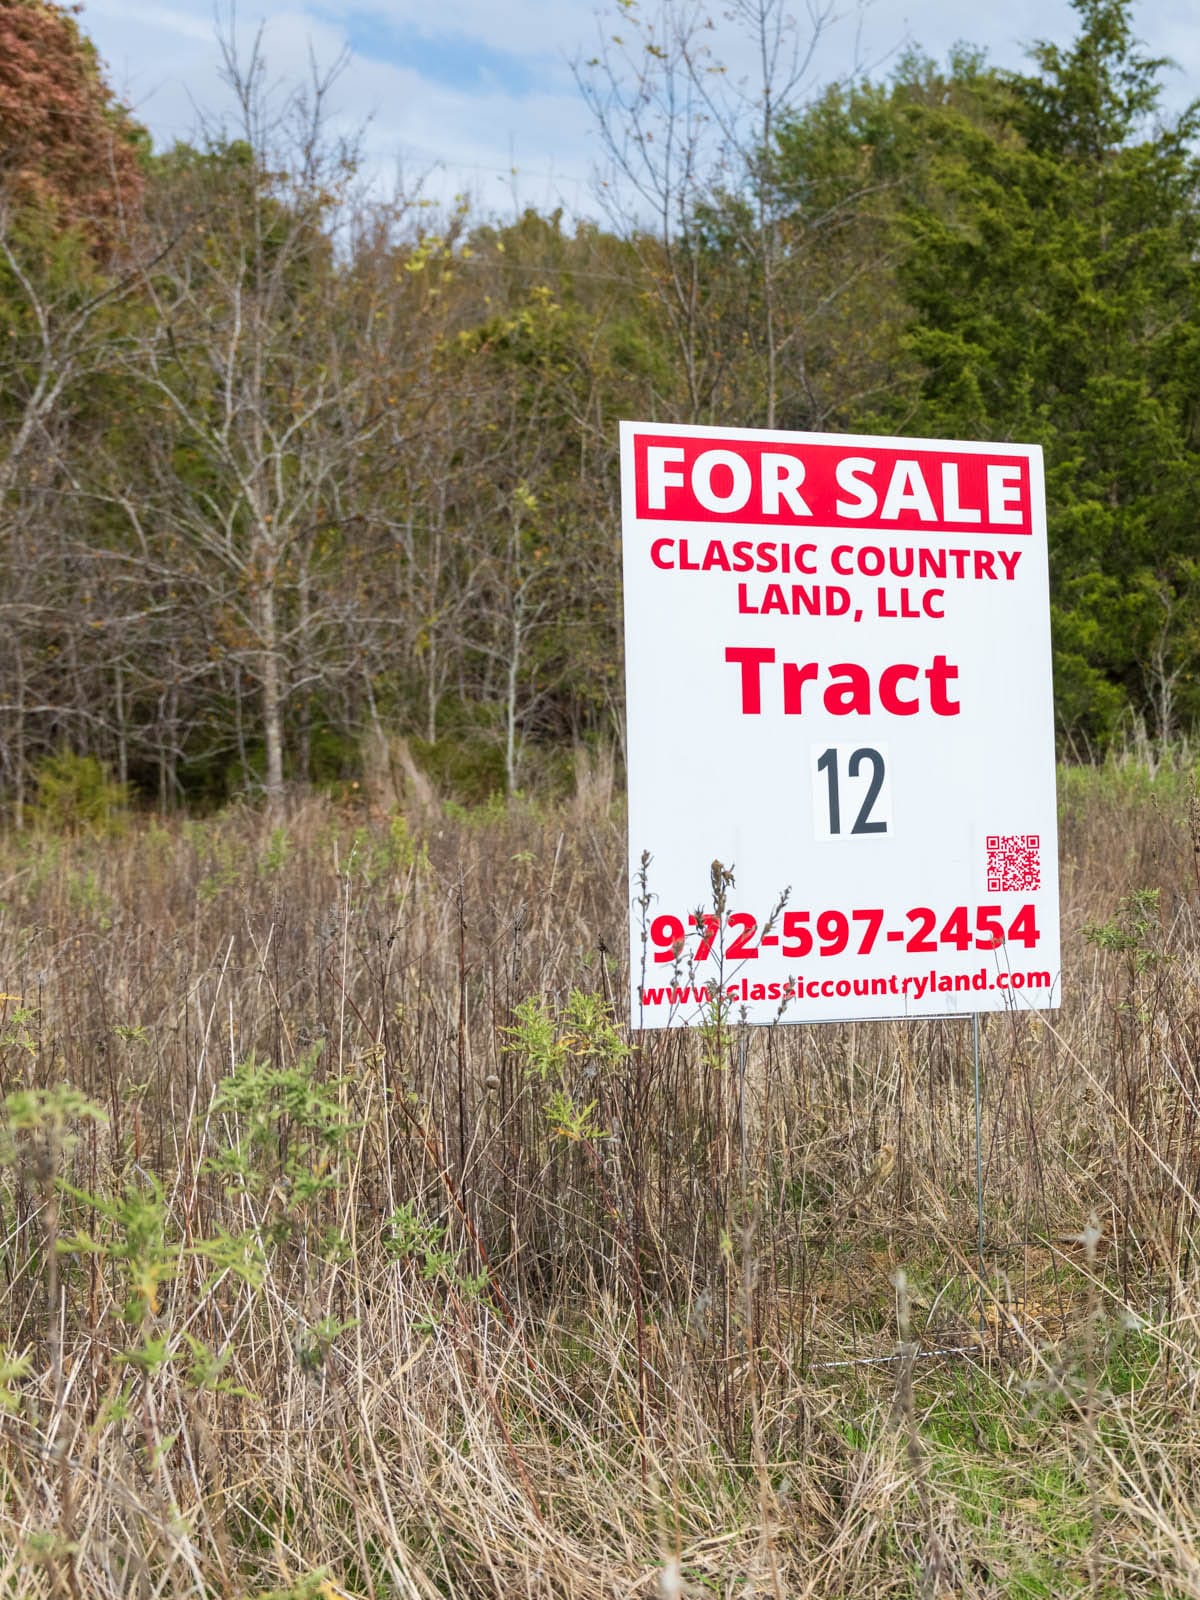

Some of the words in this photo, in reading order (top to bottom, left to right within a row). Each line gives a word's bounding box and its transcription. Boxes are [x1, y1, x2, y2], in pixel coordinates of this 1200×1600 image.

[646, 446, 813, 516] FOR
[835, 457, 1024, 525] SALE
[650, 538, 817, 574] CLASSIC
[831, 546, 1022, 580] COUNTRY
[737, 583, 863, 622] LAND,
[877, 588, 945, 618] LLC
[725, 647, 960, 716] Tract
[817, 747, 888, 834] 12
[650, 904, 1040, 963] 972-597-2454
